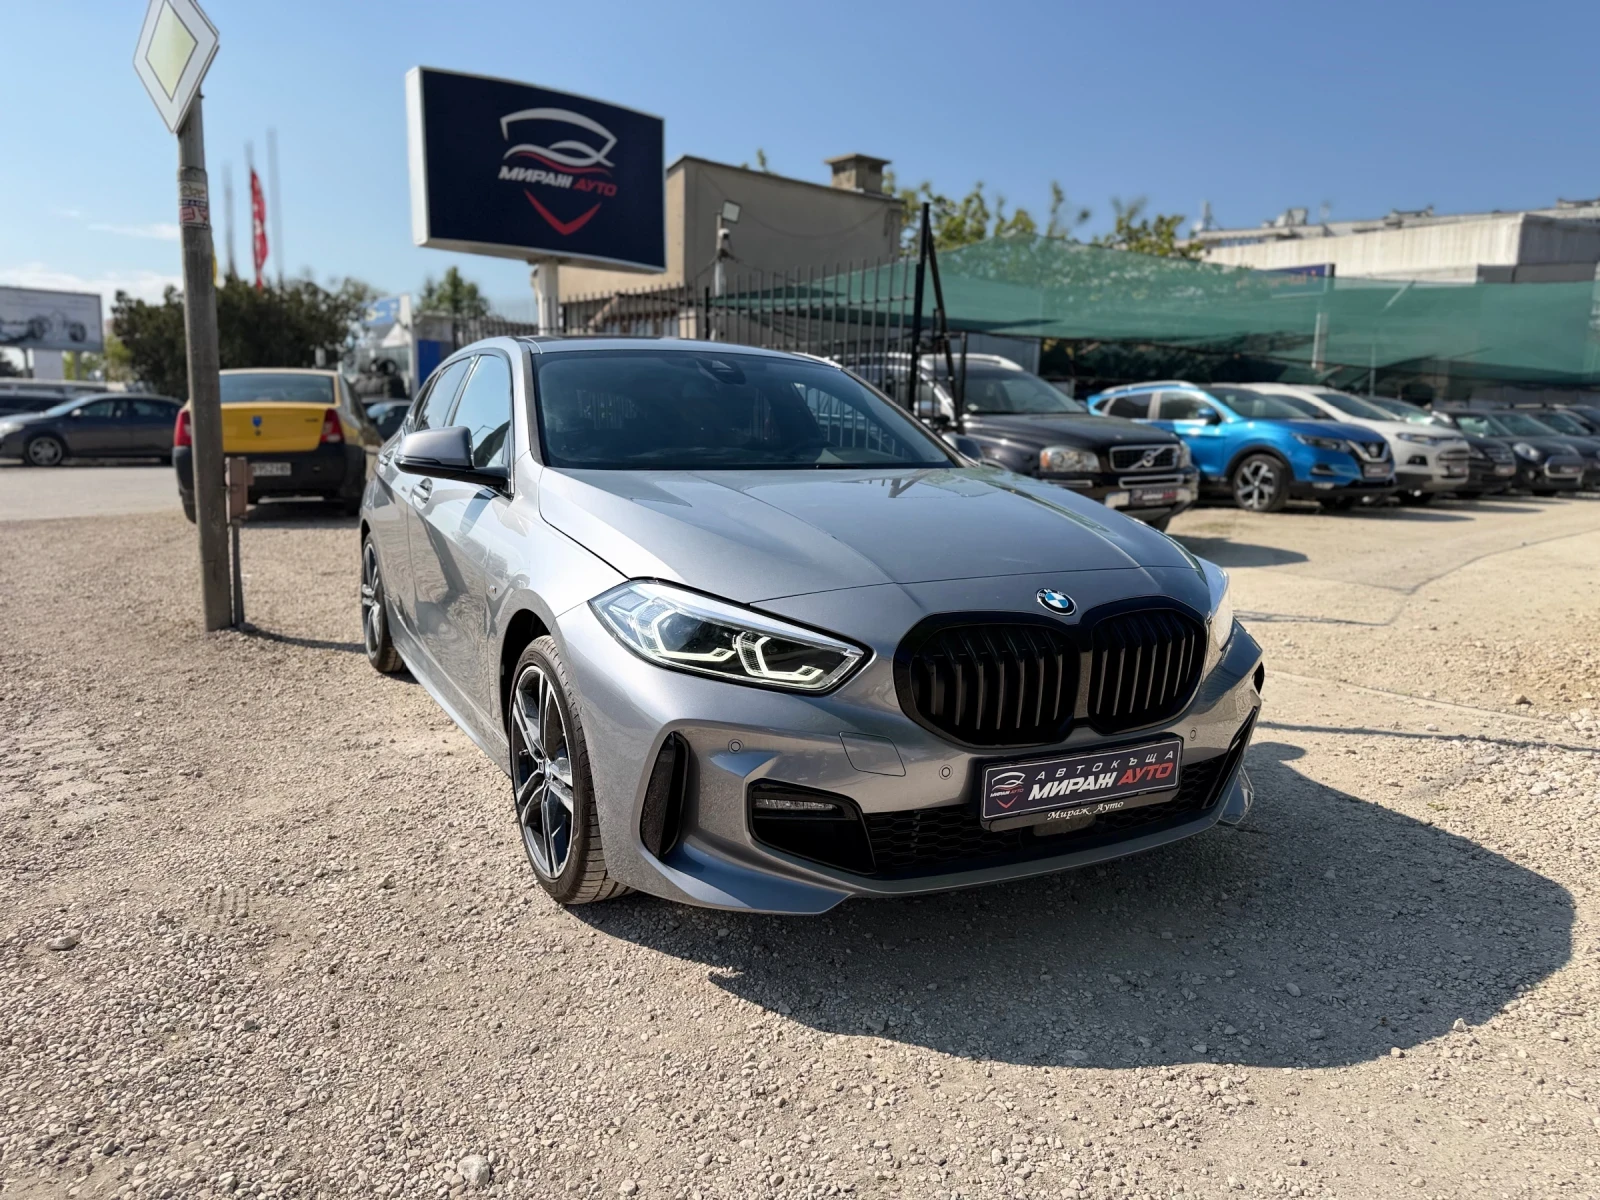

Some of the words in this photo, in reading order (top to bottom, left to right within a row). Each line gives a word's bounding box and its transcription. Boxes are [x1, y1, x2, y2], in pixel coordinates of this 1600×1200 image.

[498, 166, 573, 188] МИРАЖ
[573, 179, 617, 197] АУТО
[1035, 750, 1174, 781] АВТОКЪЩА
[1027, 771, 1117, 801] МИРАЖ
[1117, 762, 1174, 786] АУТО
